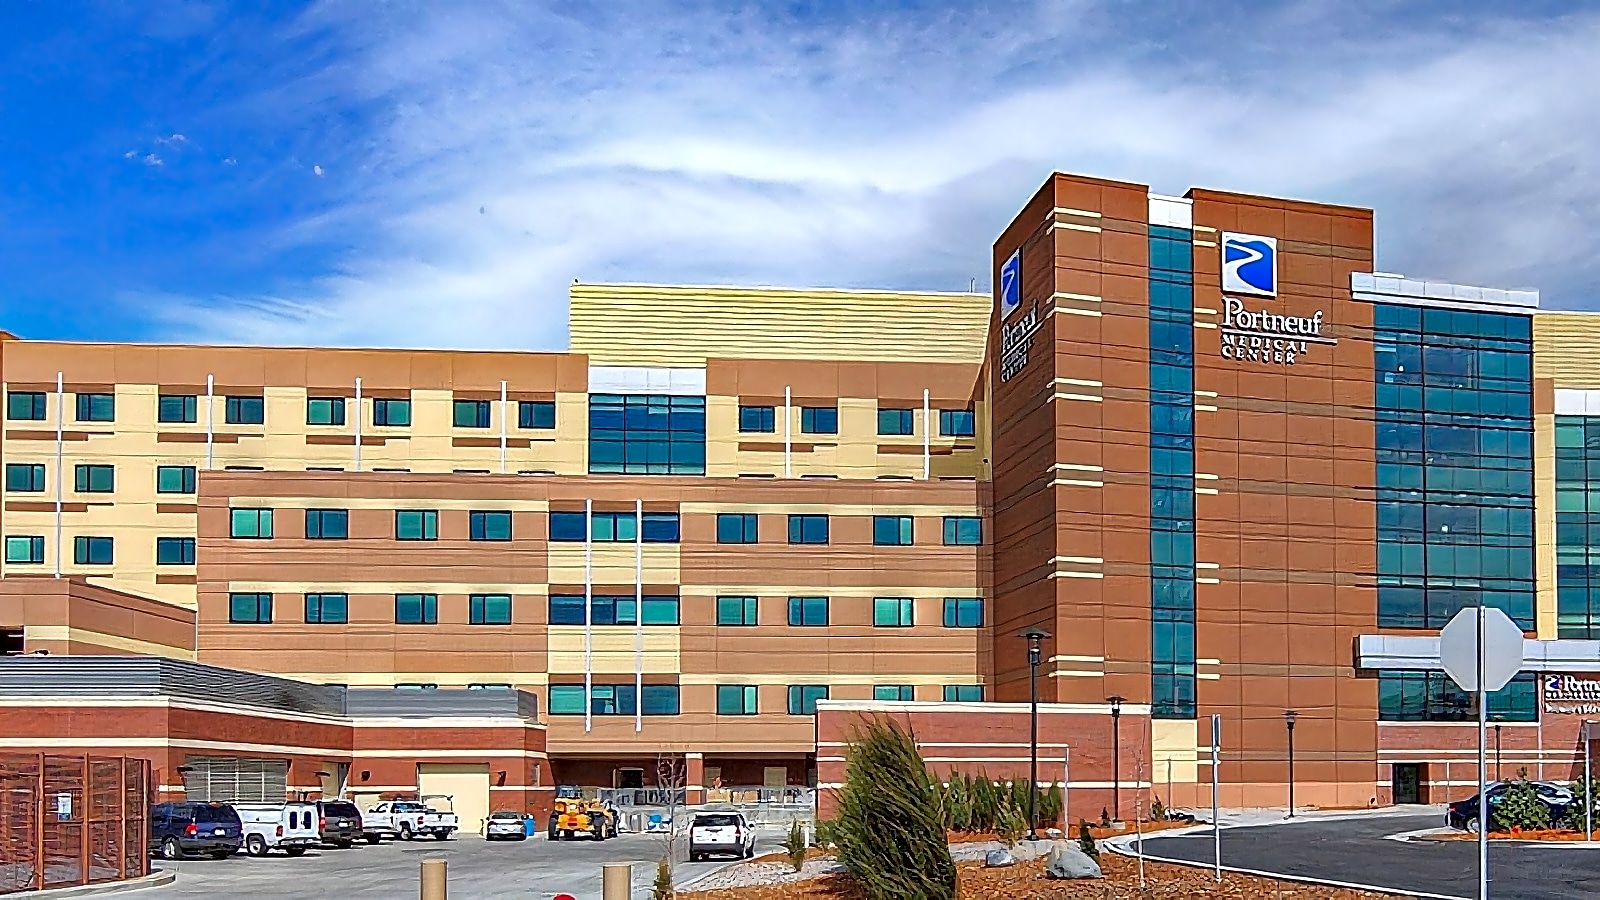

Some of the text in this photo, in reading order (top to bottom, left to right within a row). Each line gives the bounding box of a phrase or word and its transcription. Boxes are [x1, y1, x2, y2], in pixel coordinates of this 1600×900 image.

[1222, 297, 1323, 334] Portneuf
[1222, 334, 1308, 353] MEDICAL
[1222, 345, 1297, 364] CENTER
